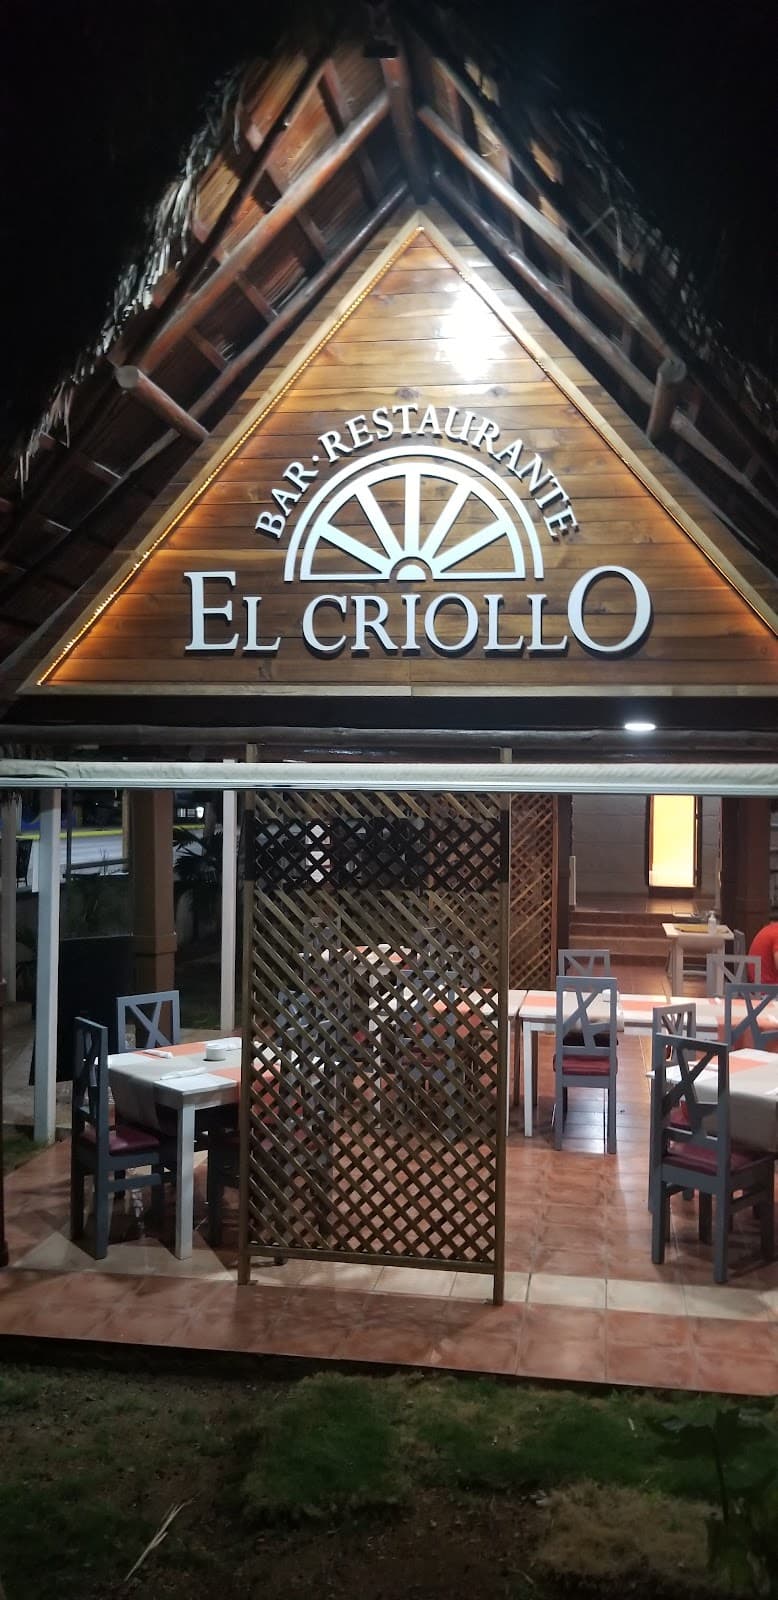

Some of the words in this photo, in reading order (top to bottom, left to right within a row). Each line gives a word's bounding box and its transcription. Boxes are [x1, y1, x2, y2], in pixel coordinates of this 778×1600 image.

[254, 460, 319, 540] BAR
[317, 403, 579, 541] RESTAURANTE
[183, 570, 281, 652] EL
[302, 565, 653, 654] CRIOLLO
